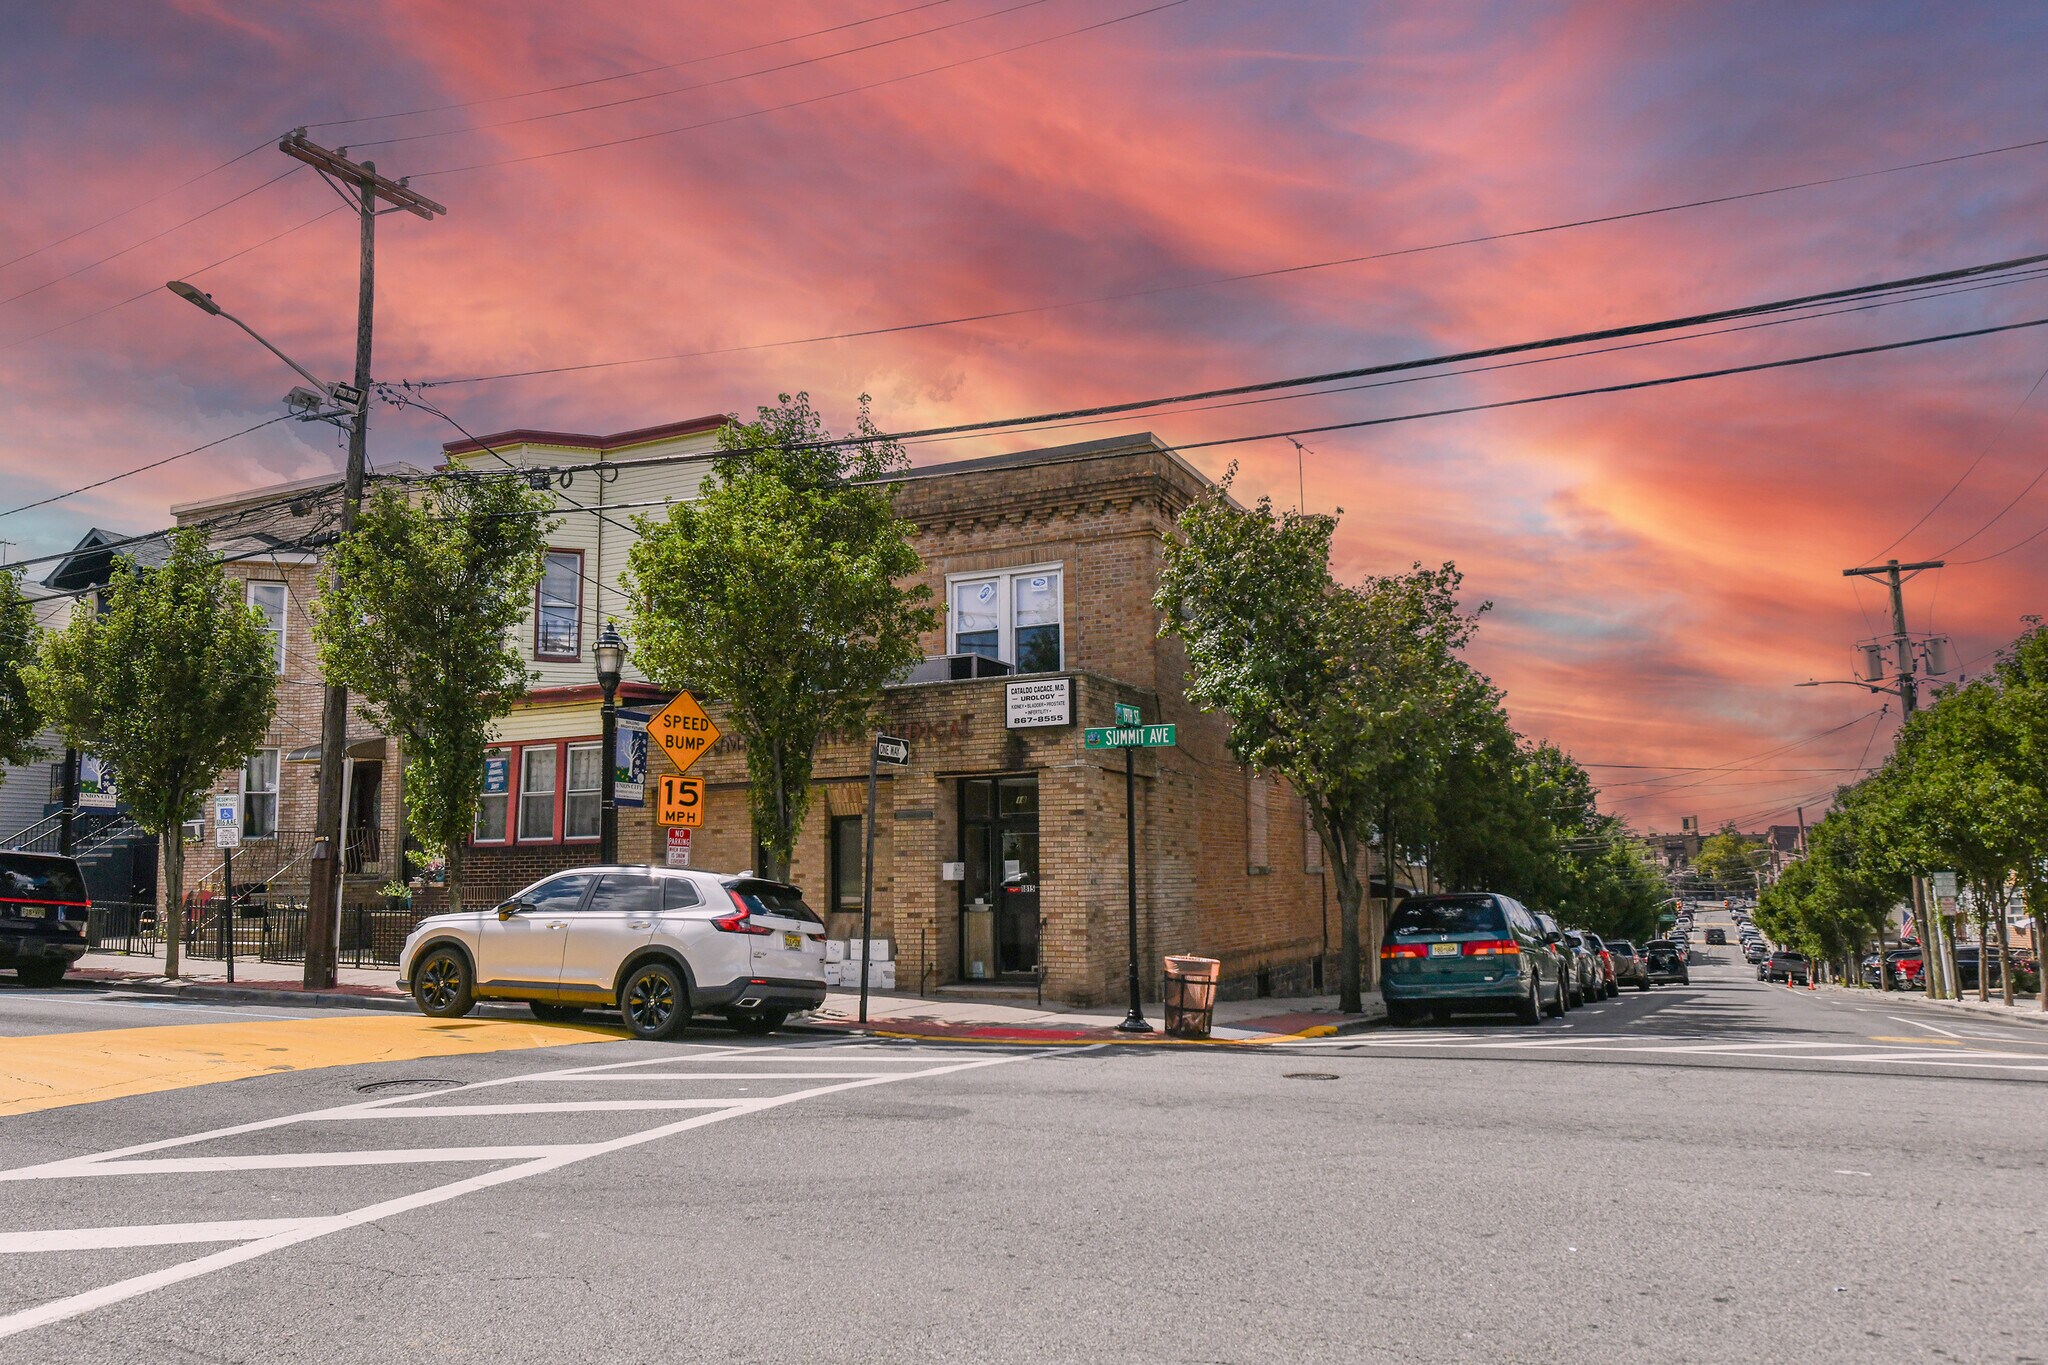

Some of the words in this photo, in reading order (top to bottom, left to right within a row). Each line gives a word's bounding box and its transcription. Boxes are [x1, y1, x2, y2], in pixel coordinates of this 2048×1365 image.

[664, 714, 708, 731] SPEED
[1014, 715, 1063, 724] 867-8555
[666, 735, 704, 750] BUMP
[1106, 729, 1144, 745] SUMMIT
[1150, 728, 1169, 743] AVE
[880, 744, 889, 755] ONE
[890, 746, 900, 757] WAY
[664, 780, 698, 806] 15
[666, 811, 695, 822] MPH
[670, 838, 690, 846] PARKING
